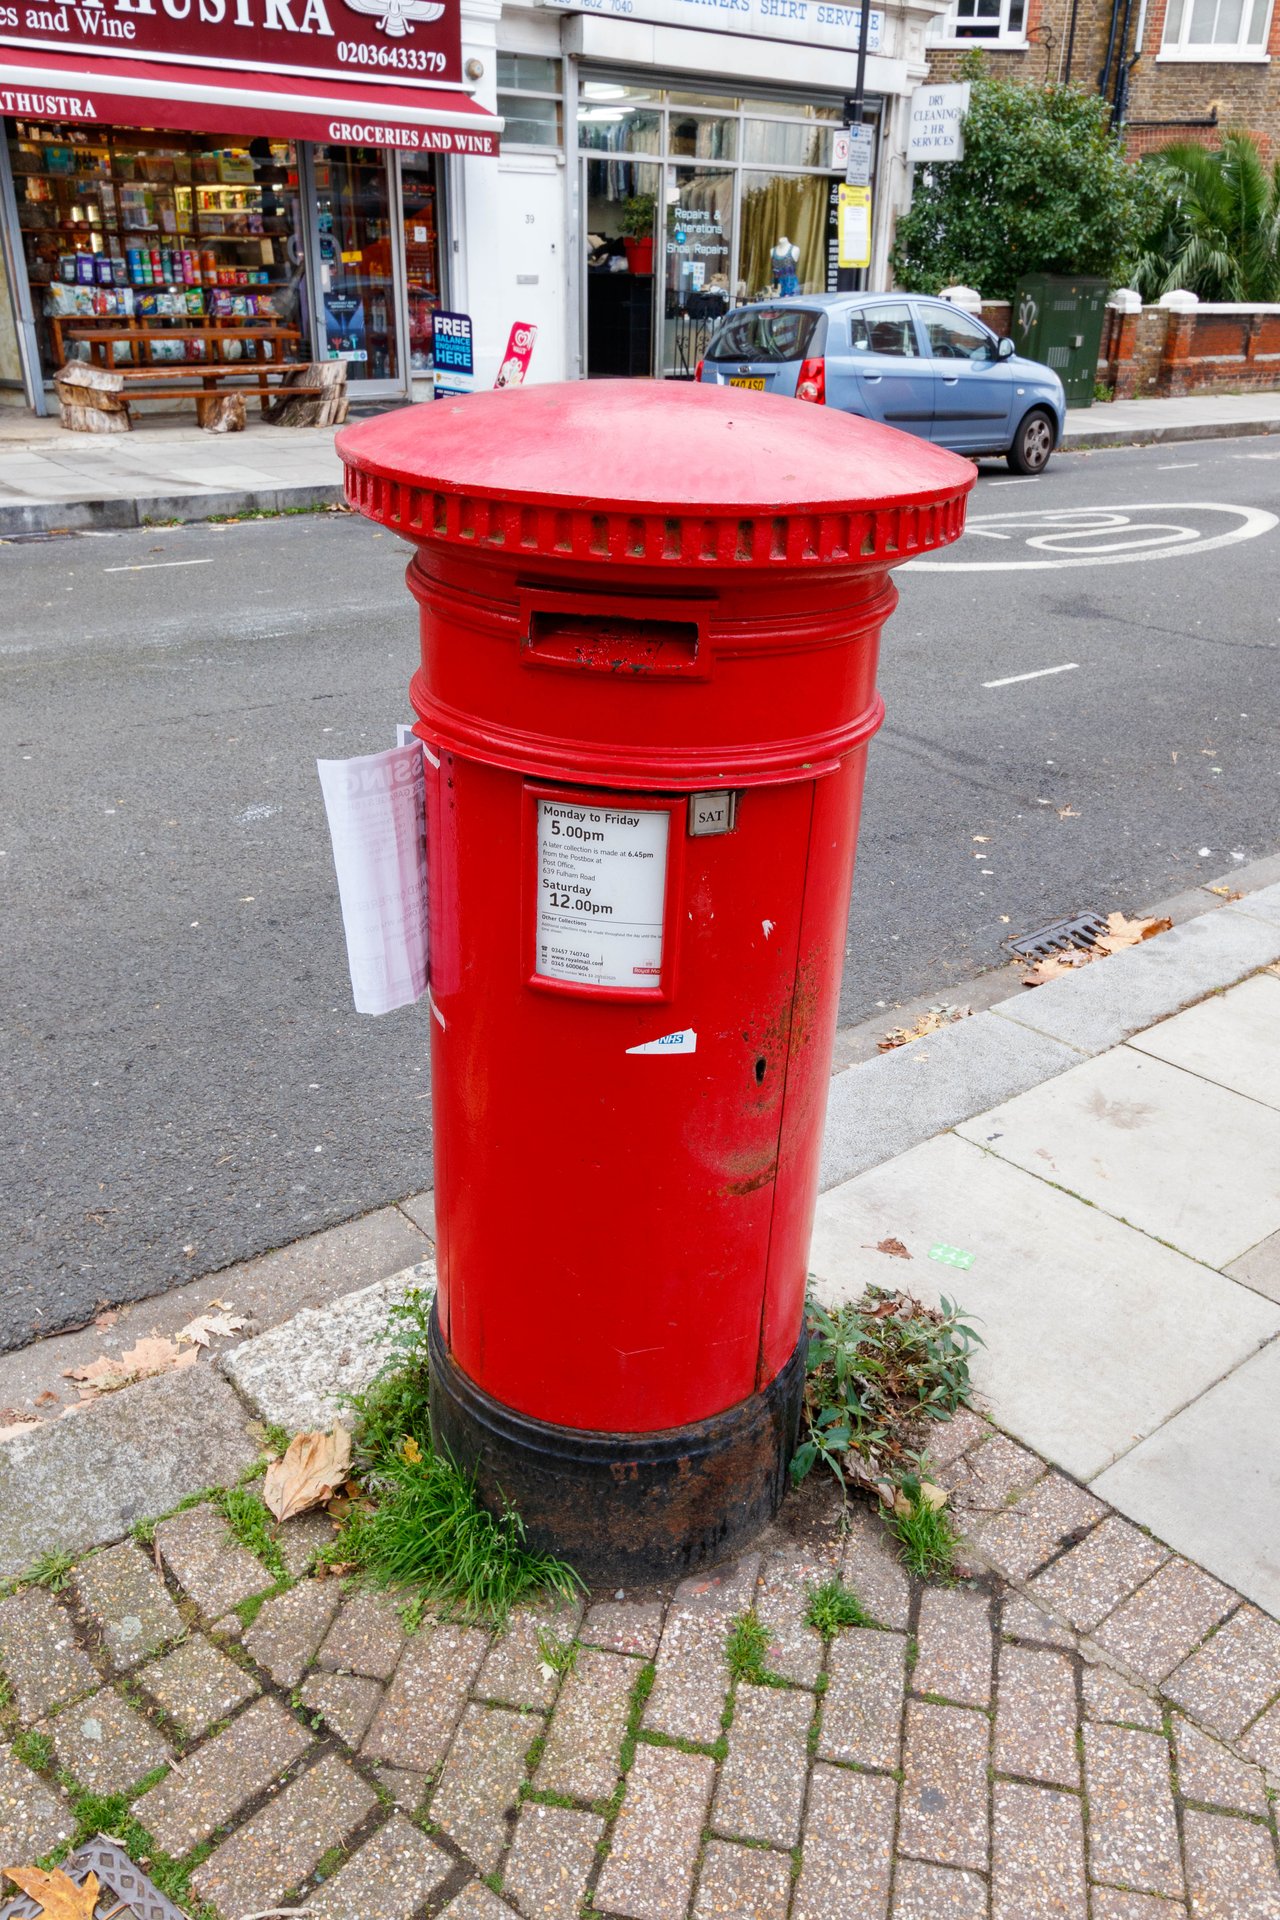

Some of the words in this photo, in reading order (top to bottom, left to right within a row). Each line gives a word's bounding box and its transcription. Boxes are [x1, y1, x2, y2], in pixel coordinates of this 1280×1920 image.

[760, 0, 808, 20] SHIRT
[817, 6, 879, 31] SERVIE
[26, 6, 70, 32] and
[74, 8, 136, 39] Wine
[337, 41, 446, 72] 02036433379
[929, 95, 944, 106] DRY
[913, 109, 958, 121] CLEANING
[923, 124, 928, 135] 2
[931, 124, 944, 135] HR
[329, 122, 419, 147] GROCERIES
[421, 132, 452, 149] AND
[454, 134, 492, 153] WINE
[912, 136, 954, 147] SERVICES
[525, 214, 535, 224] 39
[674, 208, 709, 220] Repairs
[713, 209, 721, 220] &
[674, 222, 722, 234] Alterations
[667, 243, 690, 254] Shoe
[694, 244, 728, 255] Repairs
[434, 316, 471, 337] FREE
[435, 334, 471, 346] BALANCE
[435, 342, 471, 353] ENQUIRIES
[435, 349, 471, 367] HERE
[543, 805, 586, 822] Monday
[589, 812, 600, 823] to
[605, 813, 640, 828] Friday
[698, 810, 724, 823] SAT
[551, 820, 604, 842] 5.00pm
[548, 841, 562, 850] later
[563, 844, 592, 855] collection
[600, 848, 618, 857] made
[627, 851, 654, 859] 6.45pm
[542, 849, 558, 858] from
[559, 851, 569, 860] the
[570, 854, 594, 864] Postbox
[542, 858, 556, 867] Post
[542, 867, 555, 875] 639
[556, 869, 579, 879] Fulham
[580, 873, 596, 881] Road
[542, 878, 592, 896] Saturday
[549, 892, 613, 915] 12.00pm
[541, 914, 557, 922] Other
[558, 917, 587, 927] Collections
[551, 947, 568, 955] 03457
[551, 954, 603, 966] www.royalmail.com
[566, 963, 589, 972] 6000606
[660, 1035, 683, 1044] NHS
